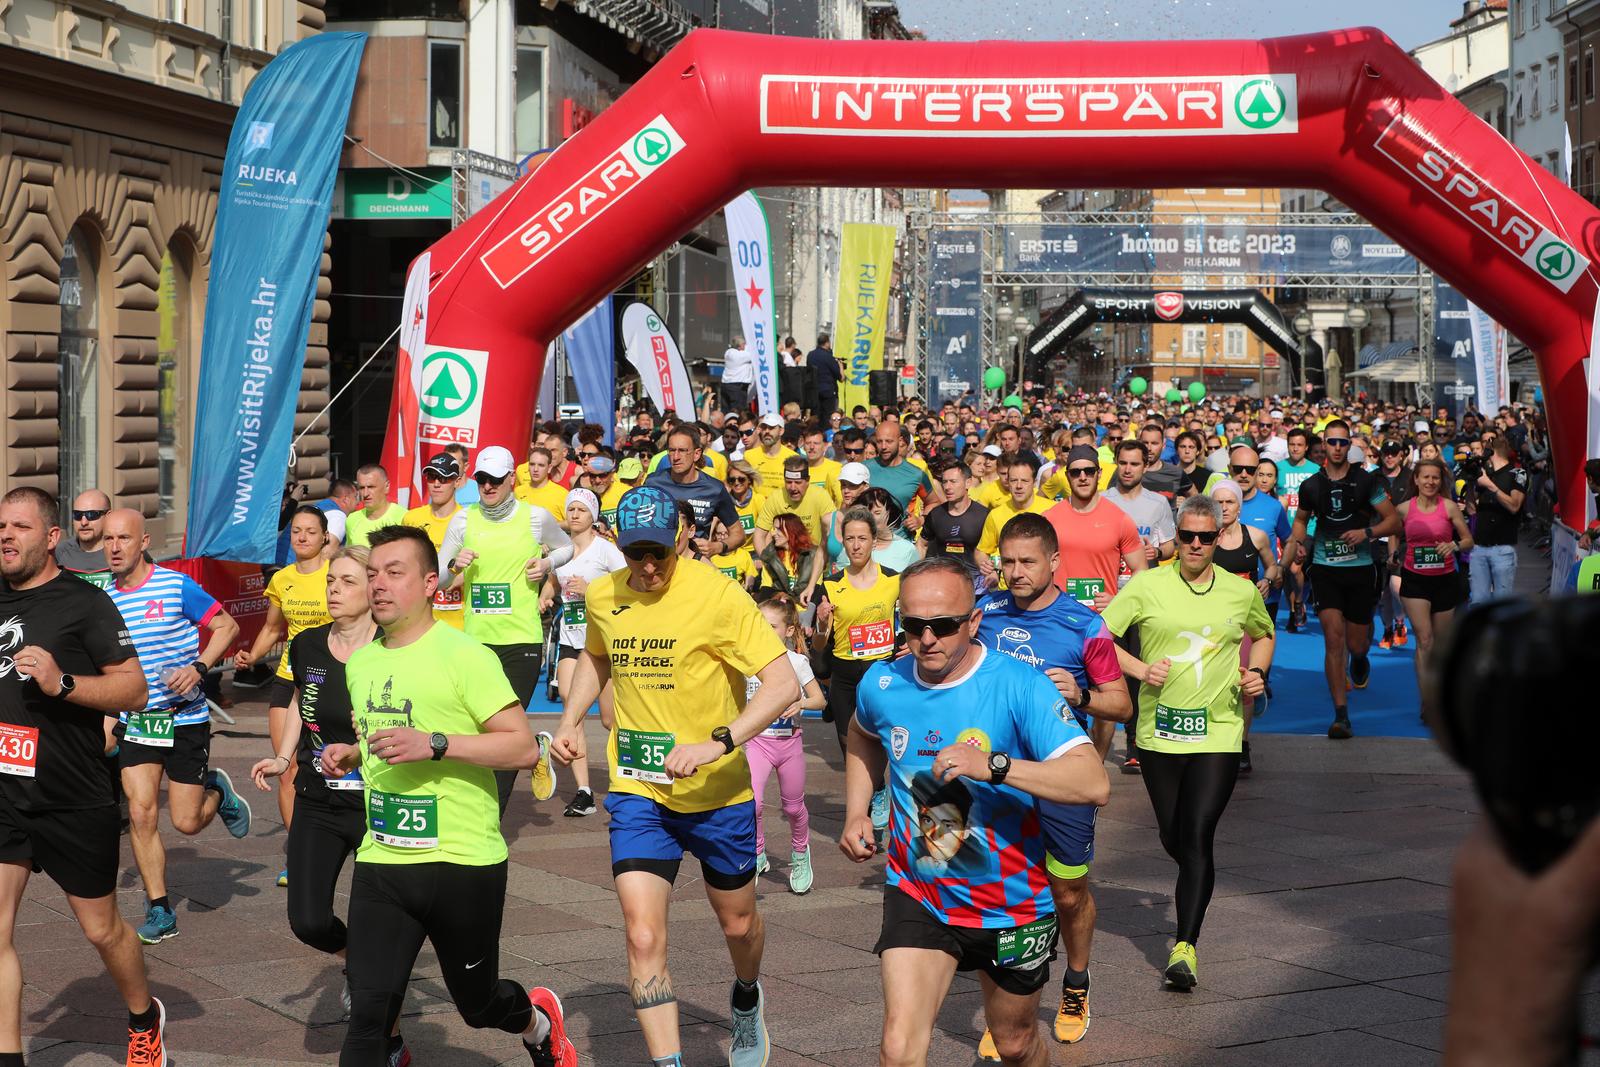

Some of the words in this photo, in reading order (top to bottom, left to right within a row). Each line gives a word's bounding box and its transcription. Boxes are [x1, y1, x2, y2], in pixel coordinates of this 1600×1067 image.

[810, 89, 1218, 123] INTERSPAR
[238, 164, 298, 185] RIJEKA
[387, 176, 412, 201] D
[520, 158, 634, 255] SPAR
[1416, 150, 1535, 249] SPAR
[369, 204, 430, 213] DEICHMANN
[937, 244, 965, 254] ERSTE
[1019, 240, 1062, 253] ERSTE
[1121, 233, 1179, 254] homo
[1183, 234, 1204, 254] si
[1207, 234, 1241, 254] teć
[1245, 233, 1296, 254] 2023
[1019, 253, 1041, 262] Bank
[1183, 256, 1241, 267] RIJEKARUN
[1094, 299, 1150, 311] SPORT
[1186, 299, 1241, 311] VISION
[849, 263, 877, 386] RIJEKARUN
[946, 334, 967, 355] A1
[1451, 338, 1471, 358] A1
[232, 277, 277, 525] www.visitRijeka.hr
[422, 424, 474, 443] PAR
[1424, 553, 1438, 562] 871
[436, 590, 461, 603] 358
[487, 591, 506, 605] 53
[1084, 584, 1100, 597] 18
[144, 599, 163, 619] 21
[985, 598, 1009, 612] HOKA
[612, 636, 637, 650] not
[639, 638, 677, 653] your
[866, 628, 891, 645] 437
[611, 653, 630, 667] PB
[633, 656, 675, 668] race.
[144, 719, 174, 735] 147
[368, 719, 407, 728] RIJEKARUN
[1172, 716, 1206, 732] 288
[0, 736, 35, 761] 430
[640, 743, 665, 767] 35
[397, 807, 427, 832] 25
[999, 935, 1016, 945] RUN
